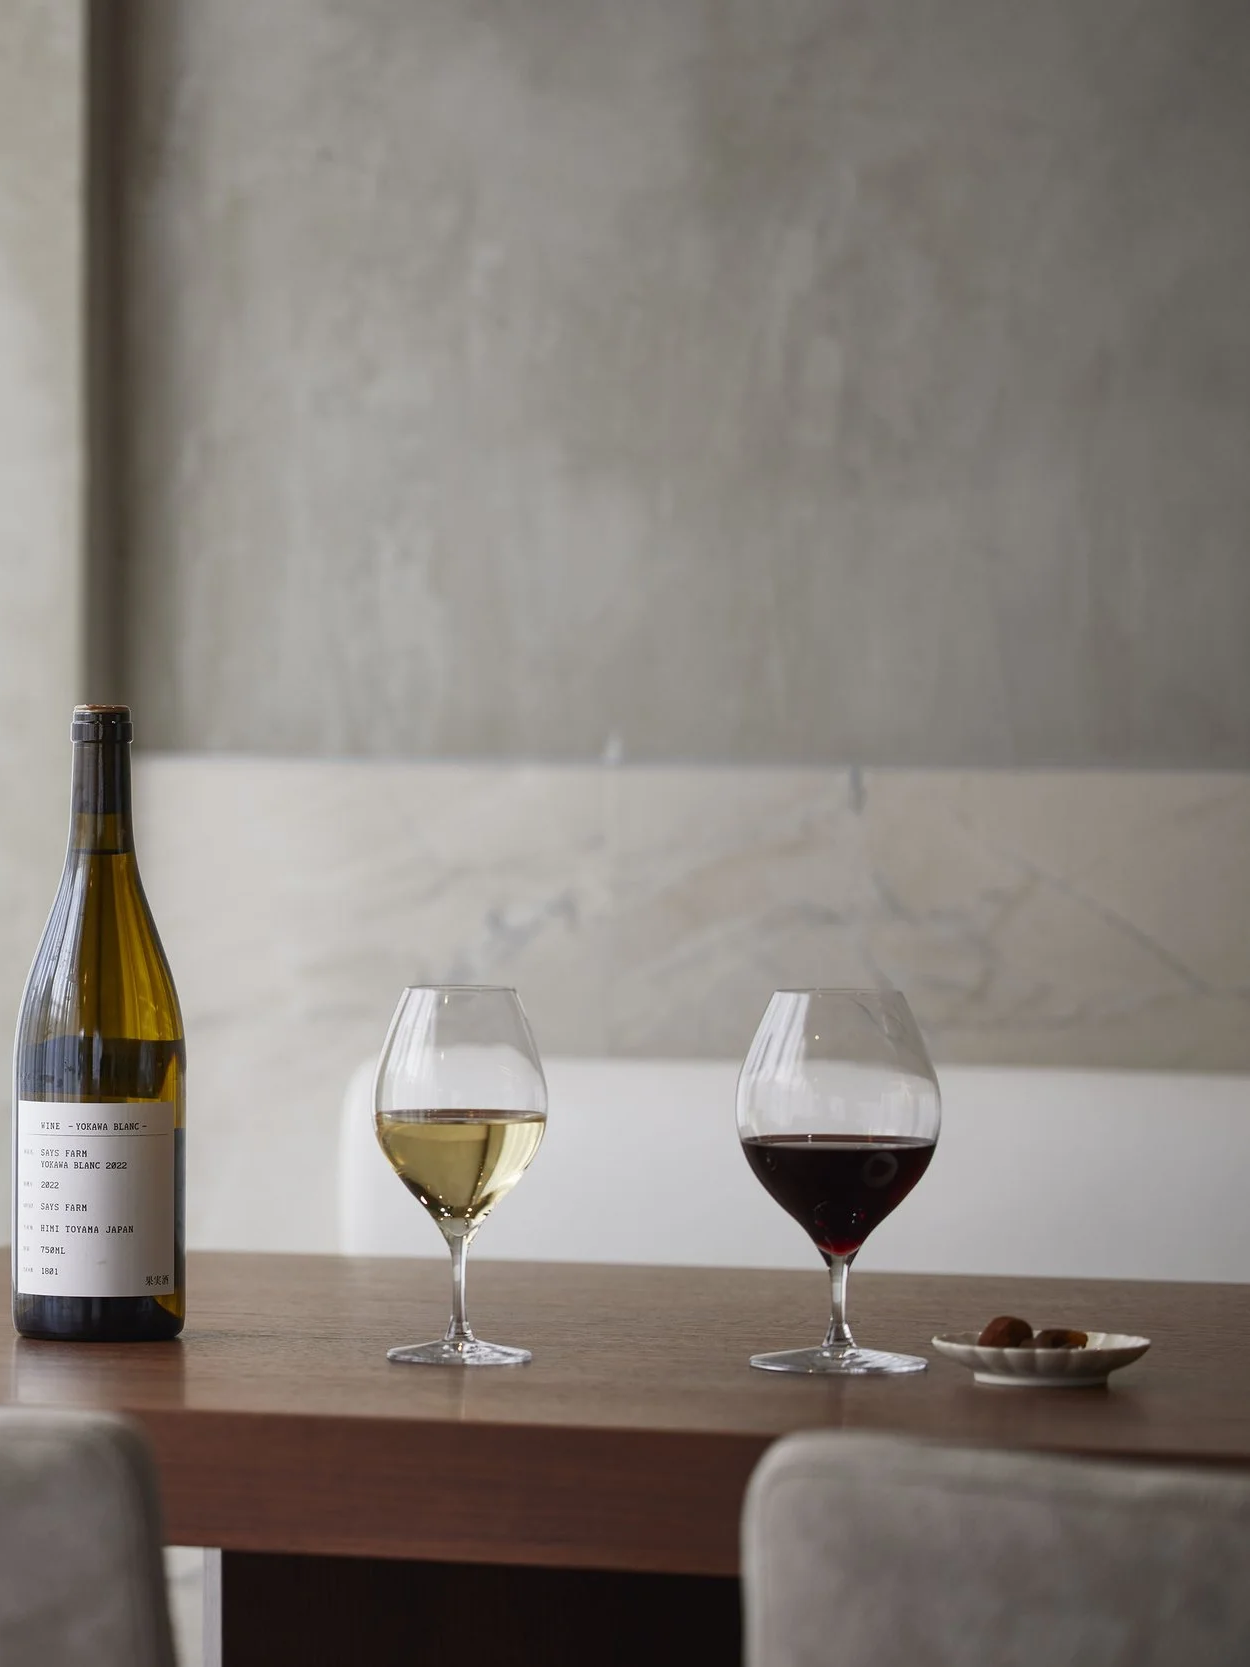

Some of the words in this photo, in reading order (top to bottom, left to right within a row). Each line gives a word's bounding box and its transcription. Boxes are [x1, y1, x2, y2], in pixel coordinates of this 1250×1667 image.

[40, 1121, 61, 1130] WINE
[40, 1148, 60, 1157] SAYS
[65, 1149, 88, 1158] FARM
[40, 1160, 69, 1169] YOKAWA
[73, 1161, 101, 1170] BLANC
[105, 1161, 128, 1170] 2022
[40, 1180, 60, 1189] 2022
[40, 1202, 60, 1211] SAYS
[65, 1203, 88, 1212] FARM
[40, 1224, 60, 1233] HIMI
[65, 1225, 99, 1234] TOYAMA
[105, 1225, 134, 1234] JAPAN
[40, 1245, 66, 1255] 750ML
[41, 1267, 58, 1275] 1801
[145, 1274, 170, 1287] 果実酒
